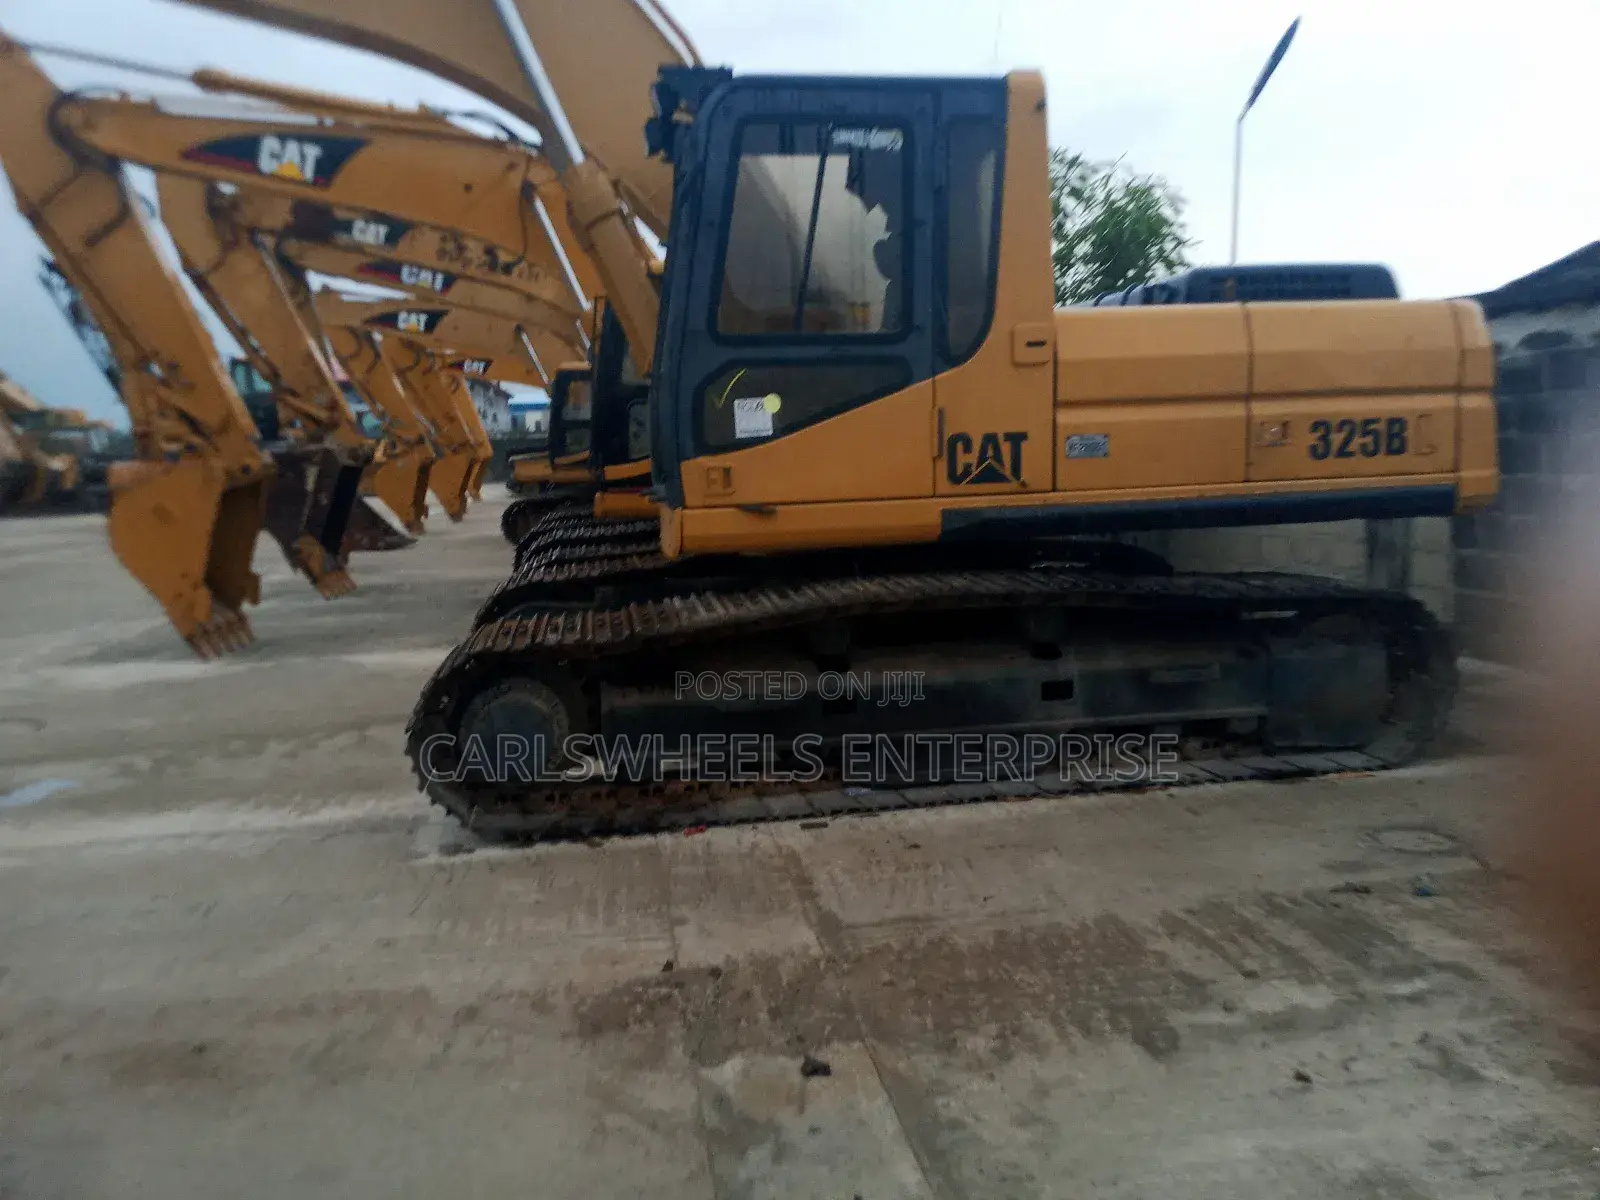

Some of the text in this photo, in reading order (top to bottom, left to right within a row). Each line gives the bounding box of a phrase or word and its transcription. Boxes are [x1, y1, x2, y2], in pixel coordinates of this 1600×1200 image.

[259, 134, 324, 183] CAT
[352, 219, 390, 246] CAT
[401, 264, 445, 291] CAT
[397, 310, 429, 332] CAT
[1309, 417, 1408, 460] 325B
[947, 431, 1028, 486] CAT
